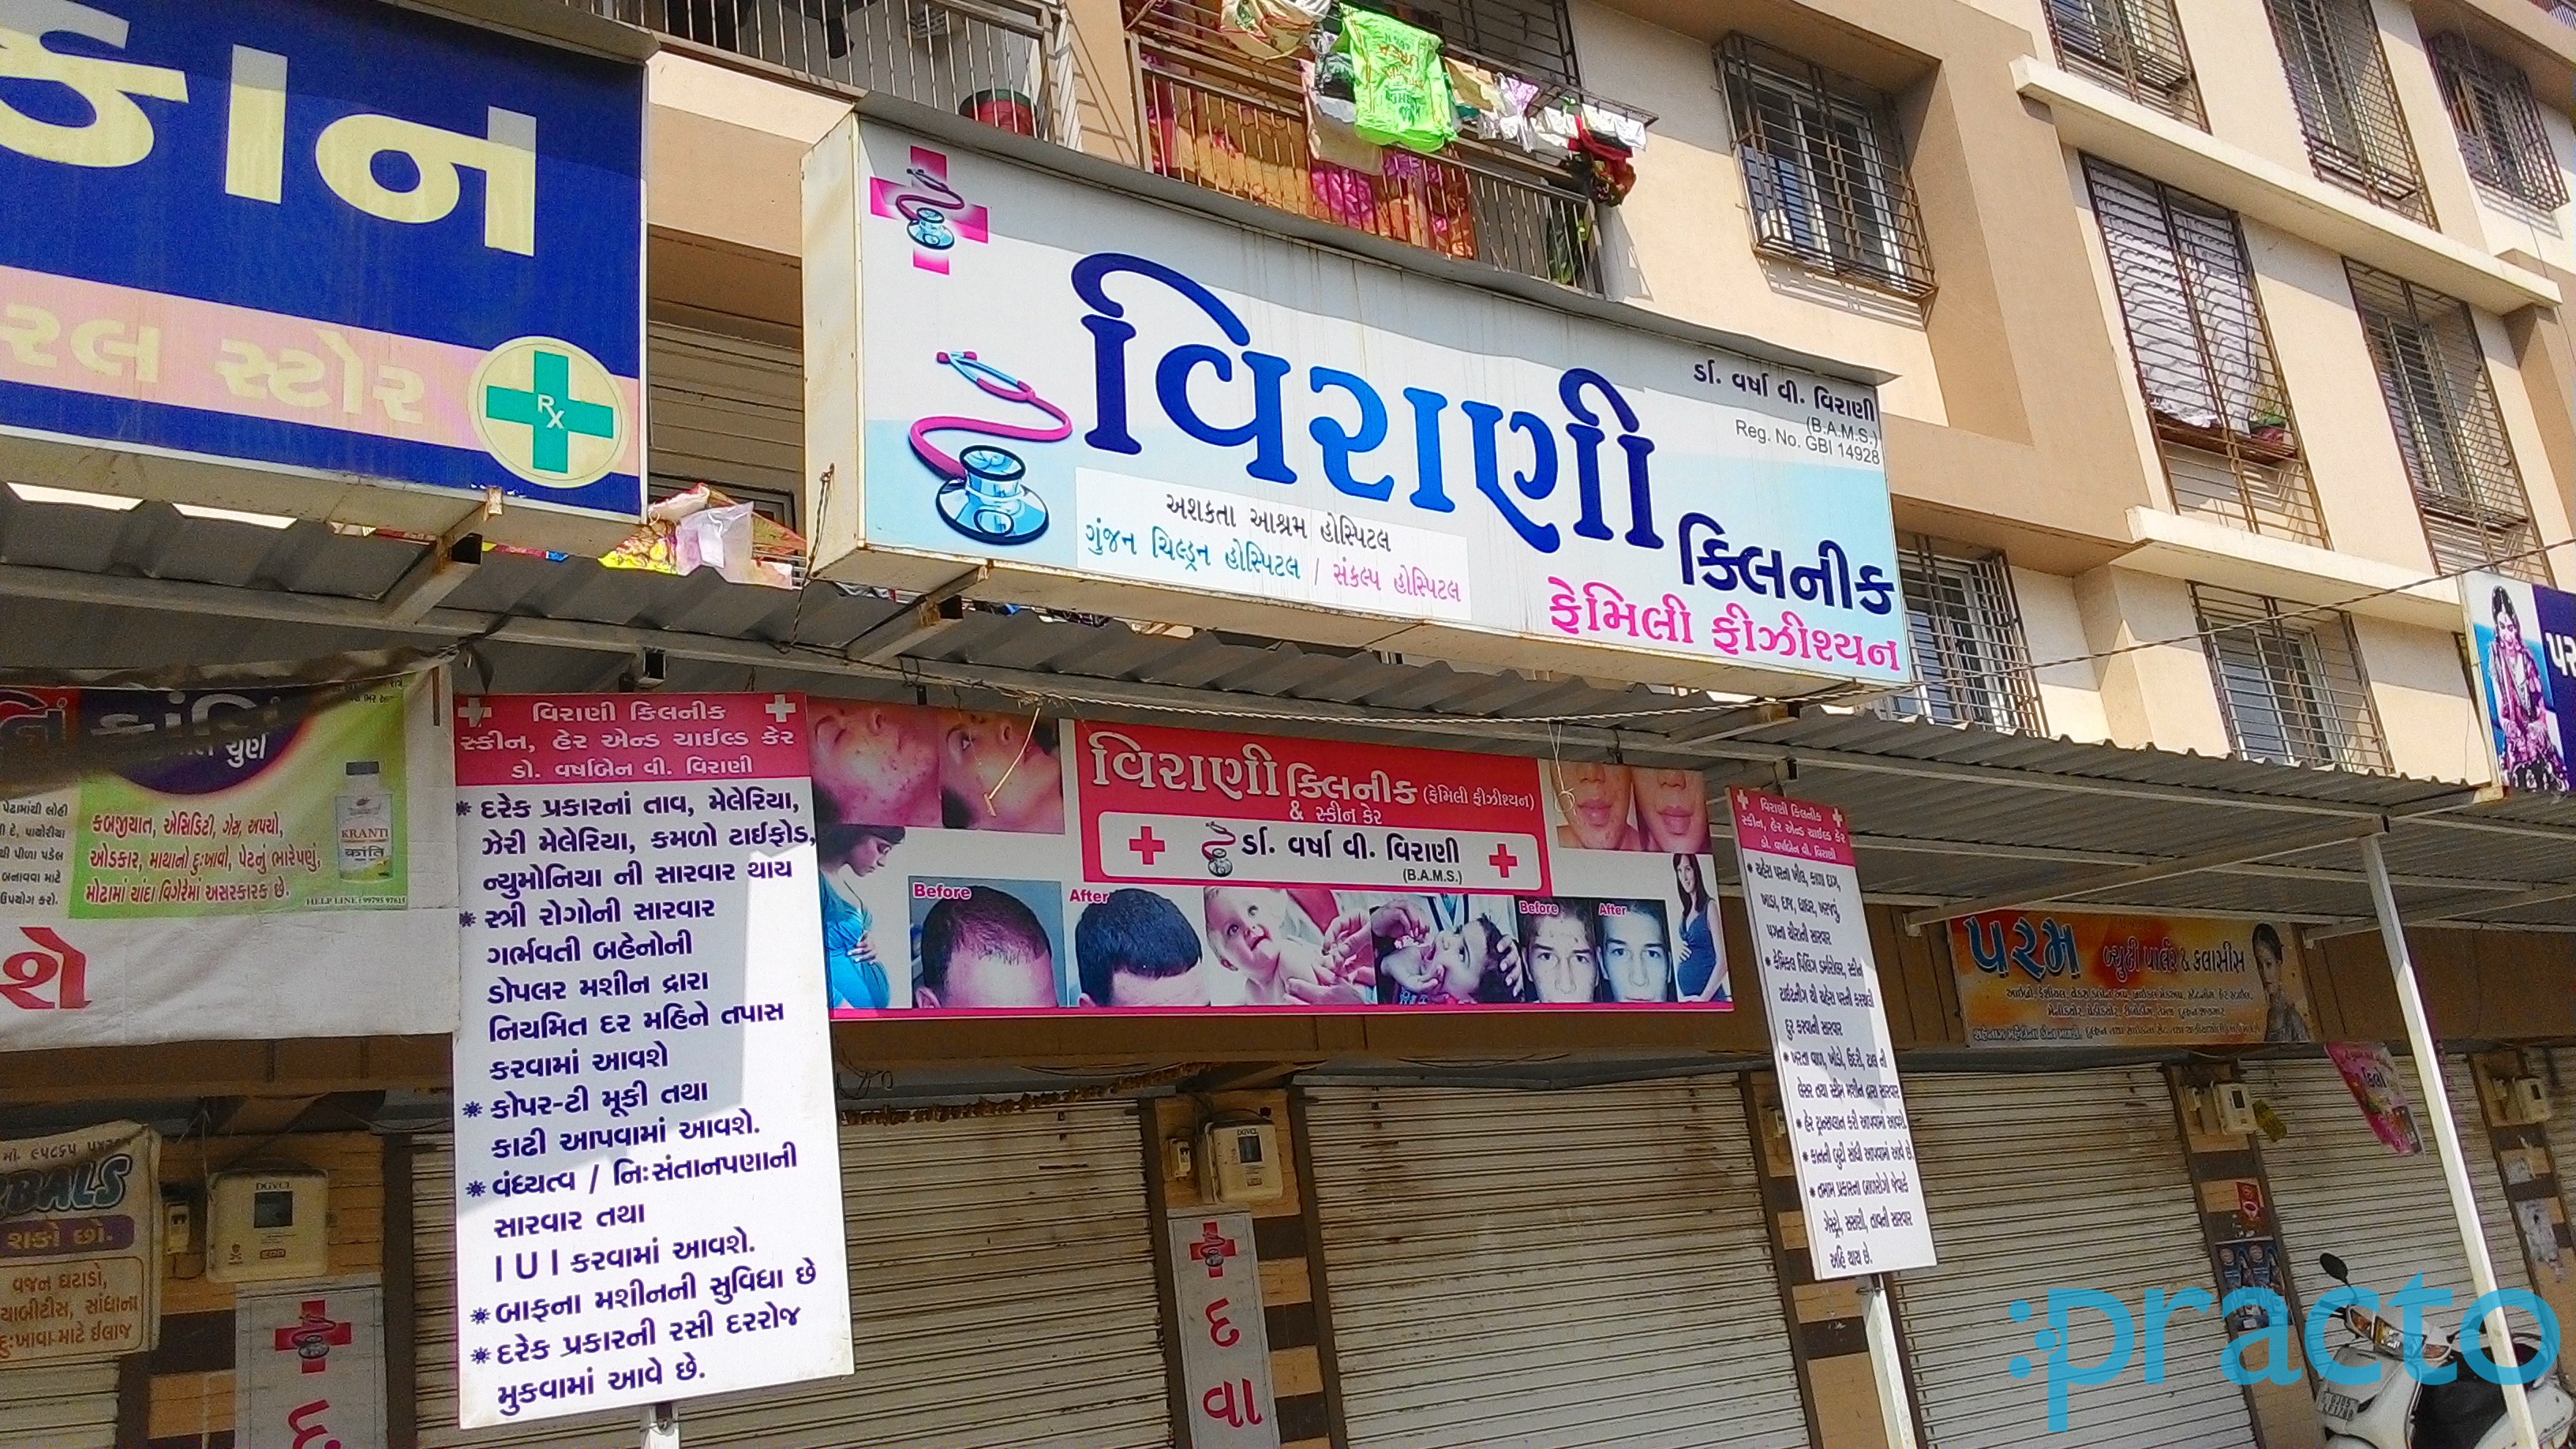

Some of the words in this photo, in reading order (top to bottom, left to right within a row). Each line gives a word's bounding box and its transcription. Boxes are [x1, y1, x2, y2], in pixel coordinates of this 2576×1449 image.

[1071, 252, 1664, 552] વિરાણી
[1732, 373, 1769, 397] વર્ષા
[1777, 380, 1806, 404] વી.
[1814, 385, 1876, 422] વિરાણી
[1735, 419, 1771, 444] Reg.
[1776, 428, 1801, 448] No.
[1805, 435, 1833, 455] GBI
[1837, 443, 1880, 465] 14928
[1806, 416, 1878, 449] (B.A.M.S.)
[1250, 507, 1308, 540] આશ્રમ
[1320, 511, 1391, 552] હોસ્પિટલ
[1085, 517, 1136, 556] ગુંજન
[1225, 538, 1301, 579] હોસ્પિટલ
[1394, 564, 1462, 602] હોસ્પિટલ
[1548, 575, 1694, 644] ફેમિલી
[533, 702, 616, 722] વિરાણી
[460, 730, 535, 753] સ્કીન,
[552, 729, 588, 750] હેર
[601, 728, 661, 749] એન્ડ
[673, 728, 750, 747] ચાઈલ્ડ
[761, 726, 795, 746] કેર
[554, 758, 632, 778] વર્ષાબેન
[642, 755, 672, 775] વી.
[686, 754, 753, 774] વિરાણી
[1088, 731, 1280, 799] વિરાણી
[481, 792, 531, 819] દરેક
[540, 791, 631, 818] પ્રકારનાં
[643, 792, 695, 817] તાવ,
[709, 787, 799, 814] મેલેરિયા,
[1290, 800, 1304, 822] &
[1316, 800, 1356, 824] સ્કીન
[1360, 803, 1383, 825] કેર
[1760, 797, 1789, 816] વિરાણી
[342, 829, 389, 839] KRANTI
[482, 829, 526, 856] ઝેરી
[539, 826, 635, 855] મેલેરિયા,
[650, 822, 717, 850] કમળો
[728, 819, 817, 848] ટાઈફોડ,
[1287, 829, 1332, 859] વર્ષા
[1343, 831, 1375, 860] વી.
[1387, 833, 1460, 864] વિરાણી
[273, 876, 290, 898] છે.
[482, 863, 601, 900] ન્યુમોનિયા
[614, 860, 643, 887] ની
[654, 862, 736, 885] સારવાર
[747, 859, 793, 880] થાય
[913, 882, 972, 900] Before
[1402, 867, 1463, 886] (B.A.M.S.)
[485, 902, 526, 929] સ્ત્રી
[539, 897, 621, 927] રોગોની
[634, 898, 716, 922] સારવાર
[1069, 889, 1109, 904] After
[1519, 900, 1559, 915] Before
[1598, 902, 1627, 916] After
[487, 935, 581, 967] ગર્ભવતી
[593, 929, 693, 960] બહેનોની
[1964, 915, 2081, 982] પરમ
[487, 976, 567, 1005] ડોપલર
[579, 969, 650, 998] મશીન
[489, 1011, 588, 1043] નિયમિત
[600, 1013, 631, 1035] દર
[644, 1000, 710, 1032] મહિને
[721, 1002, 784, 1025] તપાસ
[489, 1048, 579, 1080] કરવામાં
[592, 1040, 669, 1072] આવશે
[490, 1085, 589, 1120] કોપર-ટી
[661, 1082, 709, 1105] તથા
[491, 1127, 546, 1160] કાઢી
[560, 1121, 666, 1152] આપવામાં
[679, 1108, 760, 1140] આવશે.
[589, 1164, 599, 1194] /
[494, 1211, 582, 1239] સારવાર
[596, 1204, 645, 1227] તથા
[570, 1237, 660, 1275] કરવામાં
[672, 1226, 756, 1259] આવશે.
[495, 1294, 581, 1324] બાફના
[594, 1271, 697, 1310] મશીનની
[710, 1265, 784, 1305] સુવિધા
[796, 1257, 817, 1286] છે
[496, 1334, 551, 1366] દરેક
[560, 1317, 655, 1357] પ્રકારની
[669, 1309, 713, 1341] રસી
[726, 1301, 801, 1335] દરરોજ
[497, 1366, 594, 1417] મુકવામાં
[608, 1357, 663, 1391] આવે
[676, 1352, 706, 1381] છે.
